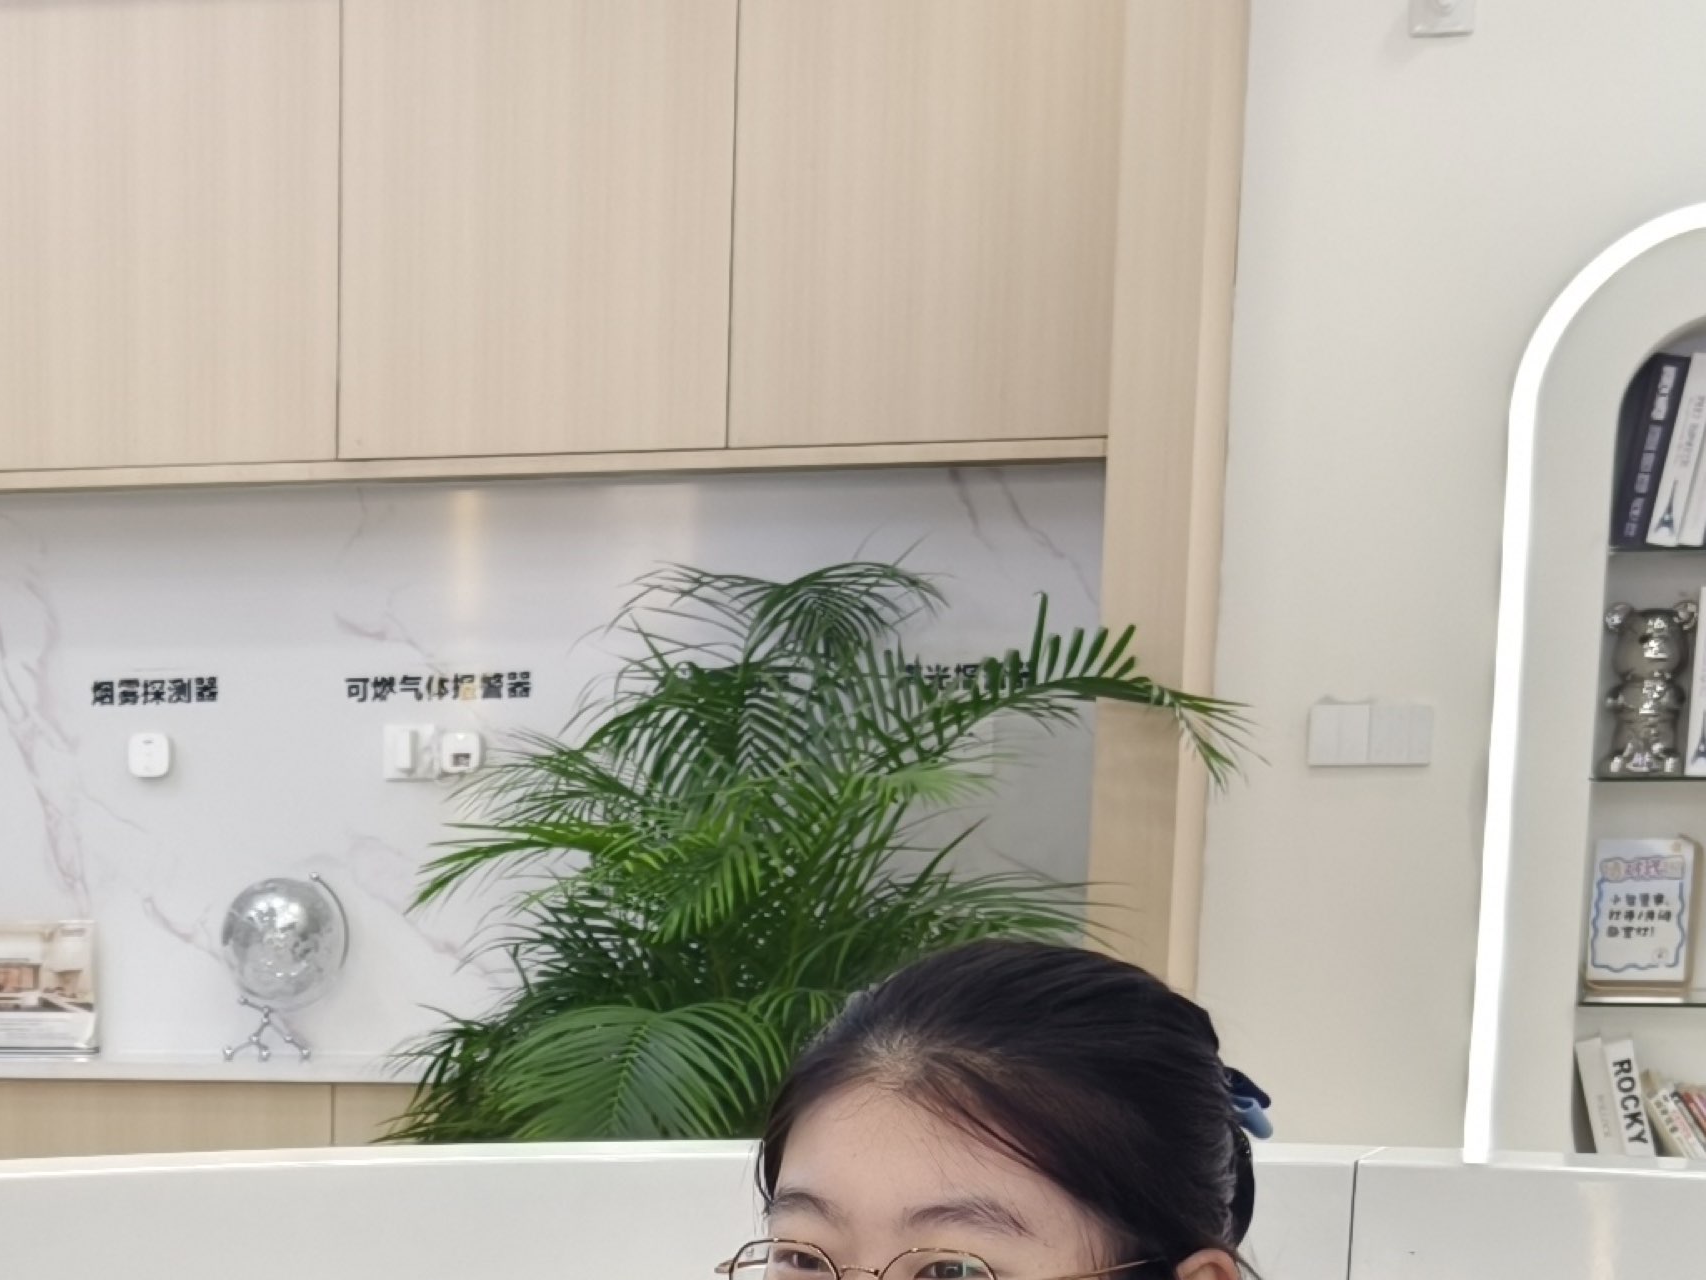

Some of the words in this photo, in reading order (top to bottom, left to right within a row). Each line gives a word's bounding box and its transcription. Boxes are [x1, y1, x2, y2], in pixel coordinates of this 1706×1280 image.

[91, 677, 218, 706] 烟雾探测器
[345, 671, 532, 703] 可燃气体报警器
[1612, 1058, 1649, 1145] ROCKY
